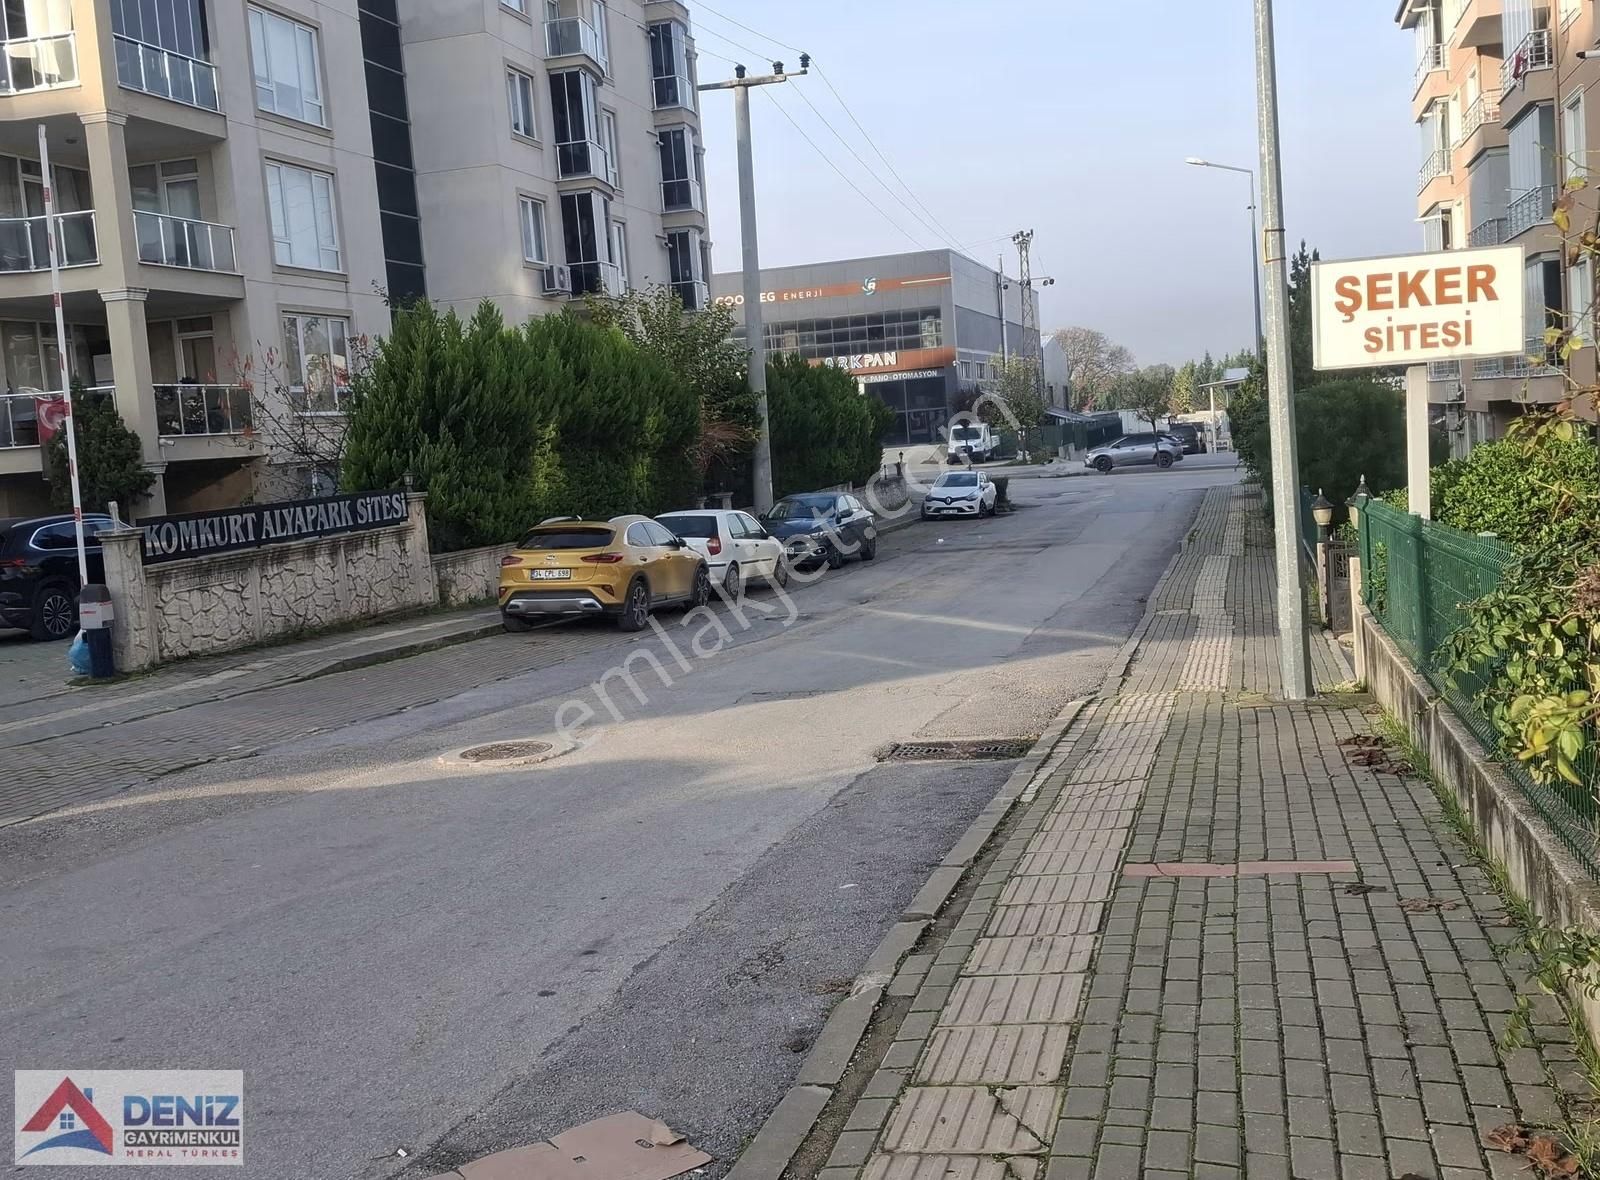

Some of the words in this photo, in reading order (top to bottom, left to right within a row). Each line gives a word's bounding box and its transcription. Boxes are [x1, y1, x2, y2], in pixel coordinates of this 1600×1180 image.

[1334, 264, 1499, 323] ŞEKER
[1363, 310, 1473, 353] SİTESİ
[825, 352, 897, 369] ARKPAN
[892, 370, 938, 381] OTOMASYON
[145, 514, 257, 556] KOMKURT
[261, 500, 353, 540] ALYAPARK
